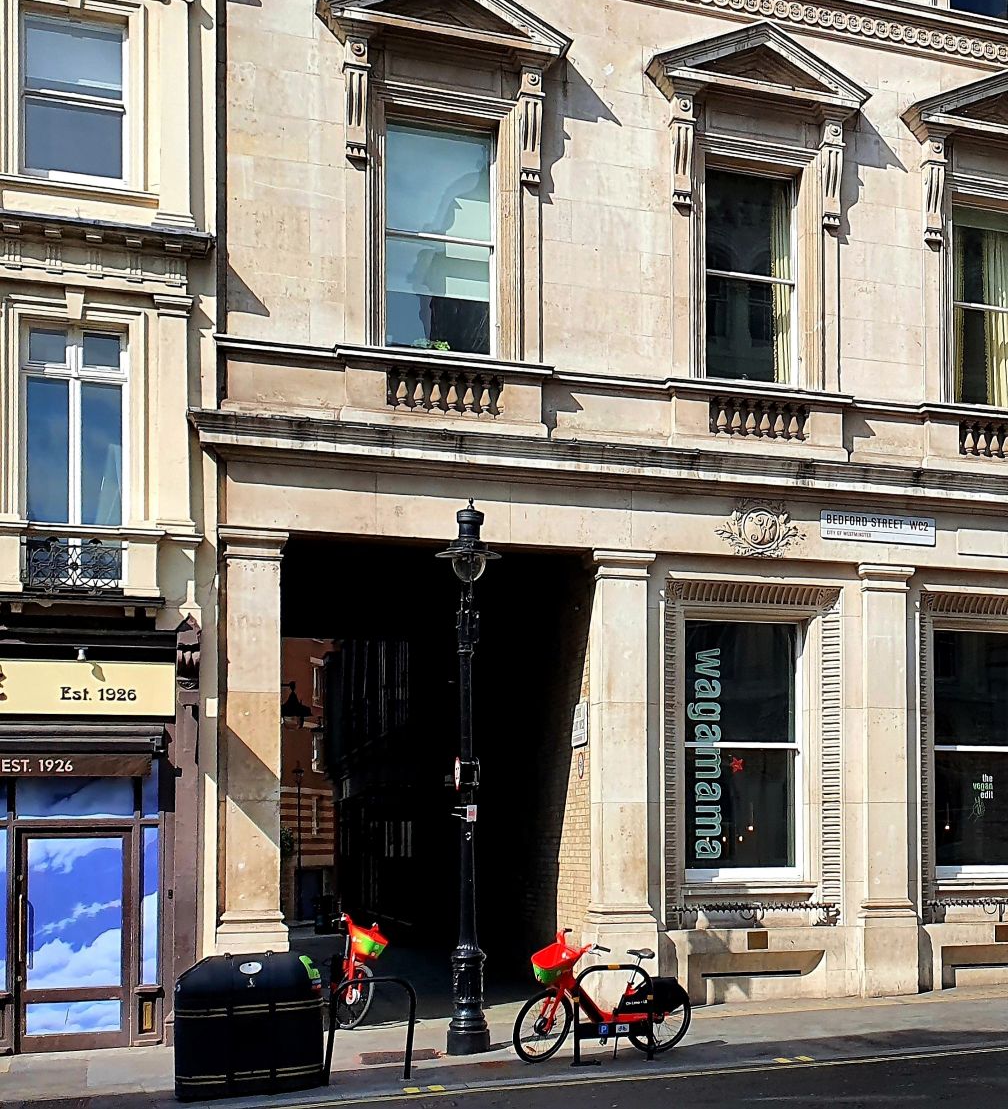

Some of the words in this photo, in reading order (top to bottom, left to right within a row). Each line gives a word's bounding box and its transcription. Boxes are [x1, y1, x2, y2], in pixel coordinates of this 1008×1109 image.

[826, 514, 868, 527] BEDFORD
[871, 517, 904, 529] STREET
[909, 520, 929, 532] WC2
[60, 686, 92, 701] Est.
[97, 688, 137, 701] 1926
[687, 648, 722, 859] wagamama
[1, 759, 32, 772] EST.
[38, 759, 74, 772] 1926
[982, 773, 993, 782] the
[972, 782, 994, 791] vegan
[980, 791, 994, 799] edit
